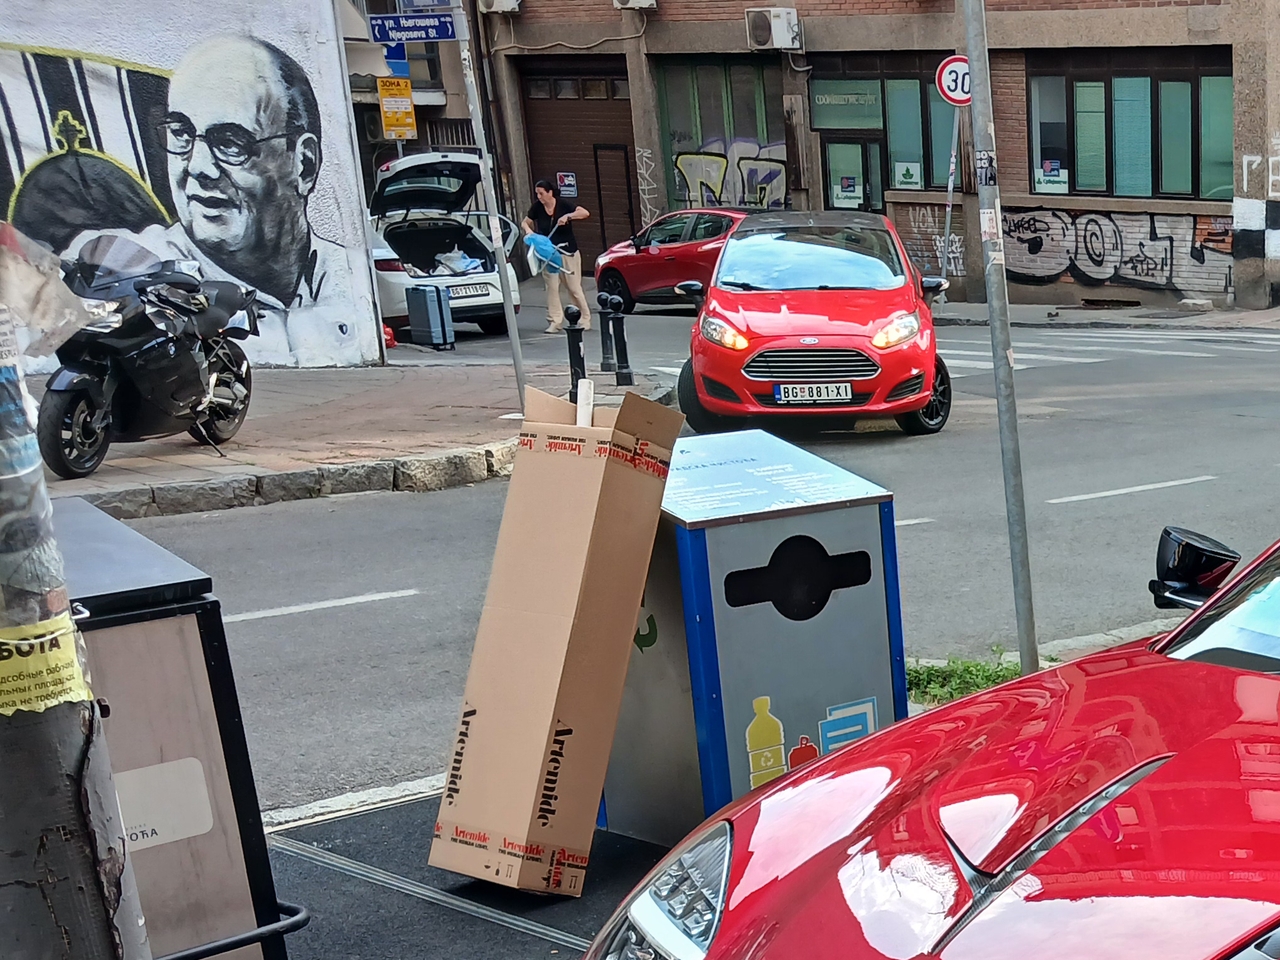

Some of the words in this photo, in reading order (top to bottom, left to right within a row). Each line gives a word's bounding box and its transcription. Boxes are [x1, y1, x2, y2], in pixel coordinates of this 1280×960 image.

[947, 69, 971, 94] 30
[783, 386, 798, 399] BG
[808, 385, 848, 398] 881-XI
[20, 697, 33, 705] не
[445, 701, 477, 806] Artemide
[537, 718, 573, 828] Artemide
